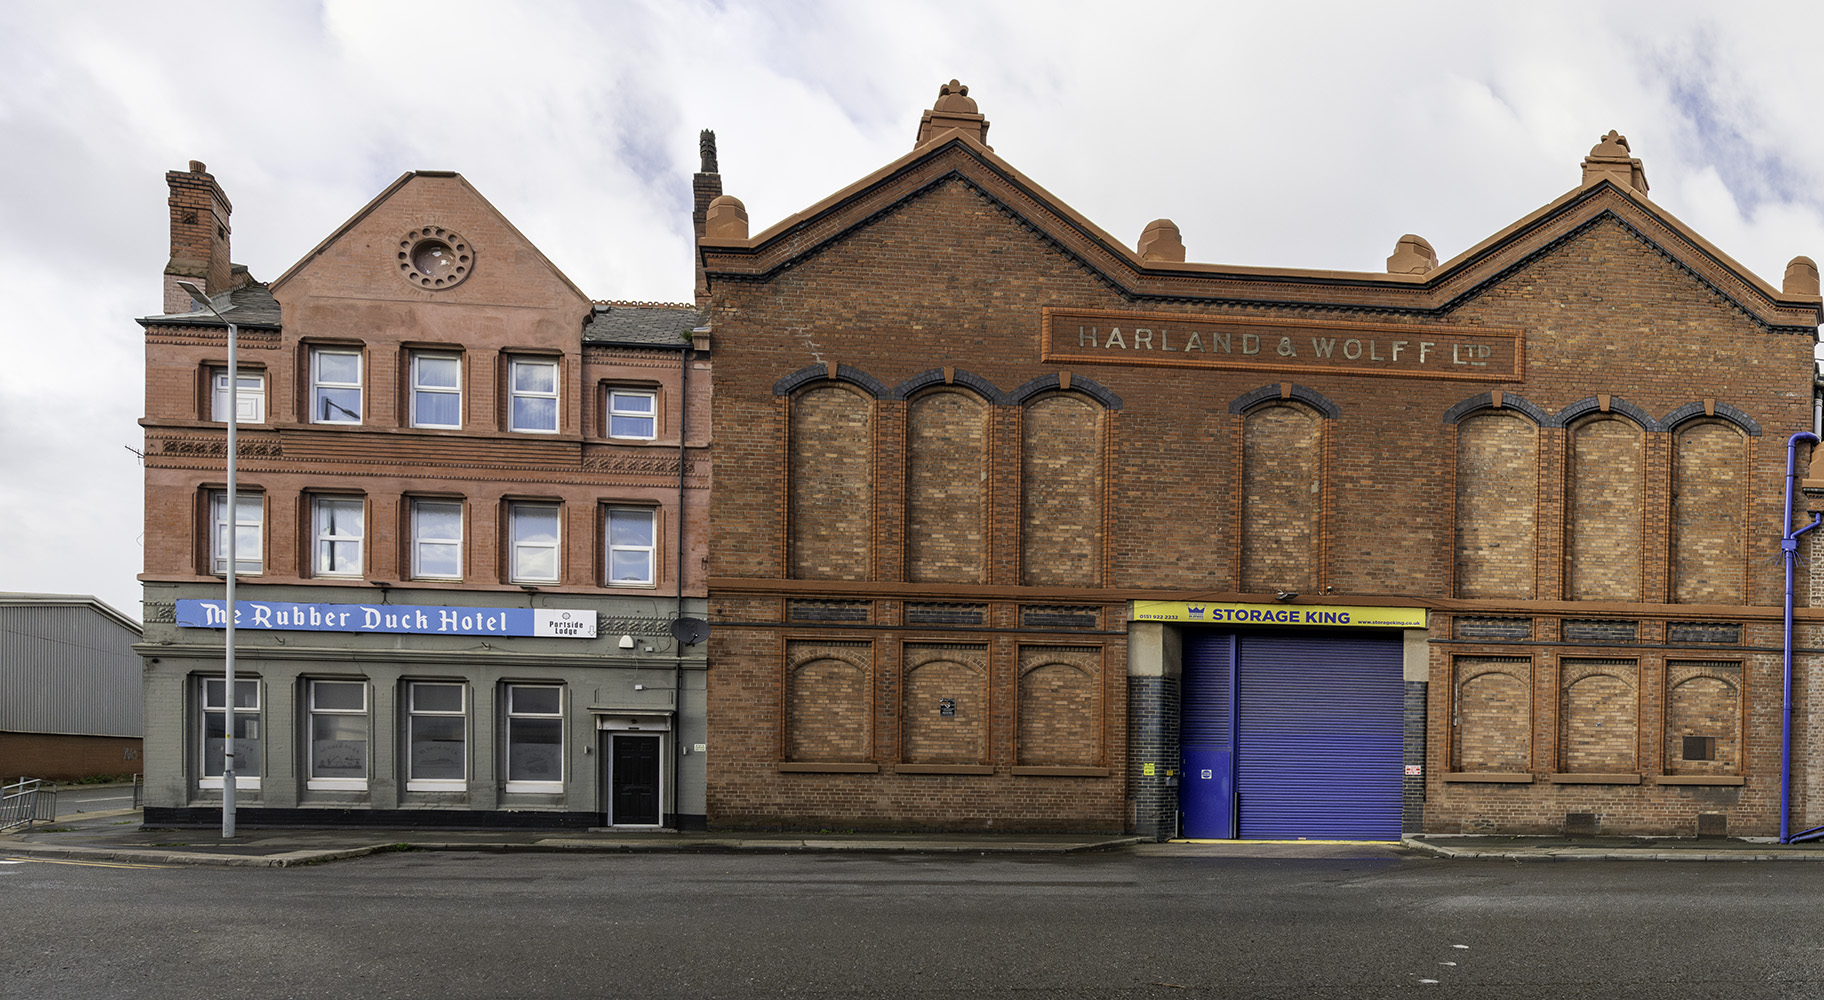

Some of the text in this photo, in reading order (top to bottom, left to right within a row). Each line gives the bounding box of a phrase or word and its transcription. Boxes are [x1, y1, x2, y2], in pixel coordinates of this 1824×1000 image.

[1079, 326, 1261, 355] HARLAND
[1276, 336, 1297, 357] &
[1312, 337, 1435, 364] WOLFF
[250, 603, 350, 628] Rubber
[360, 606, 428, 629] Duck
[437, 609, 507, 632] Hotel
[1212, 608, 1300, 623] STORAGE
[1305, 611, 1350, 624] KING
[549, 620, 584, 629] Portside
[555, 628, 578, 636] Lodge
